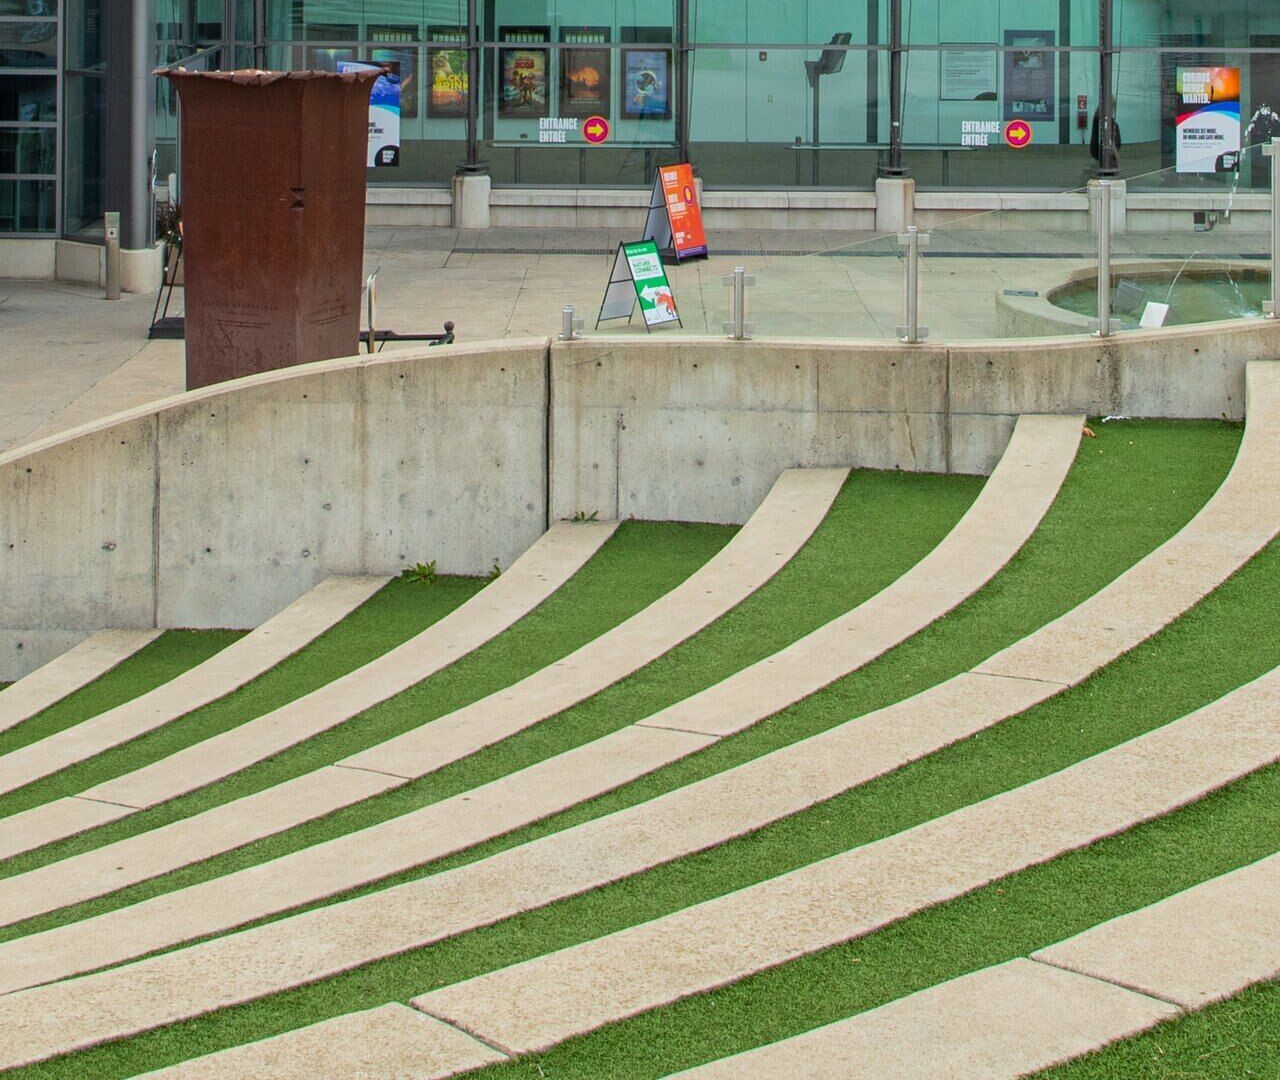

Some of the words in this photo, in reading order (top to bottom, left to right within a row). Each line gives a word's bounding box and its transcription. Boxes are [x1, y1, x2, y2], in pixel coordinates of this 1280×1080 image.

[539, 118, 578, 130] ENTRANCE
[961, 121, 1000, 133] ENTRANCE
[539, 130, 566, 143] ENTRÉE
[961, 133, 988, 146] ENTRÉE
